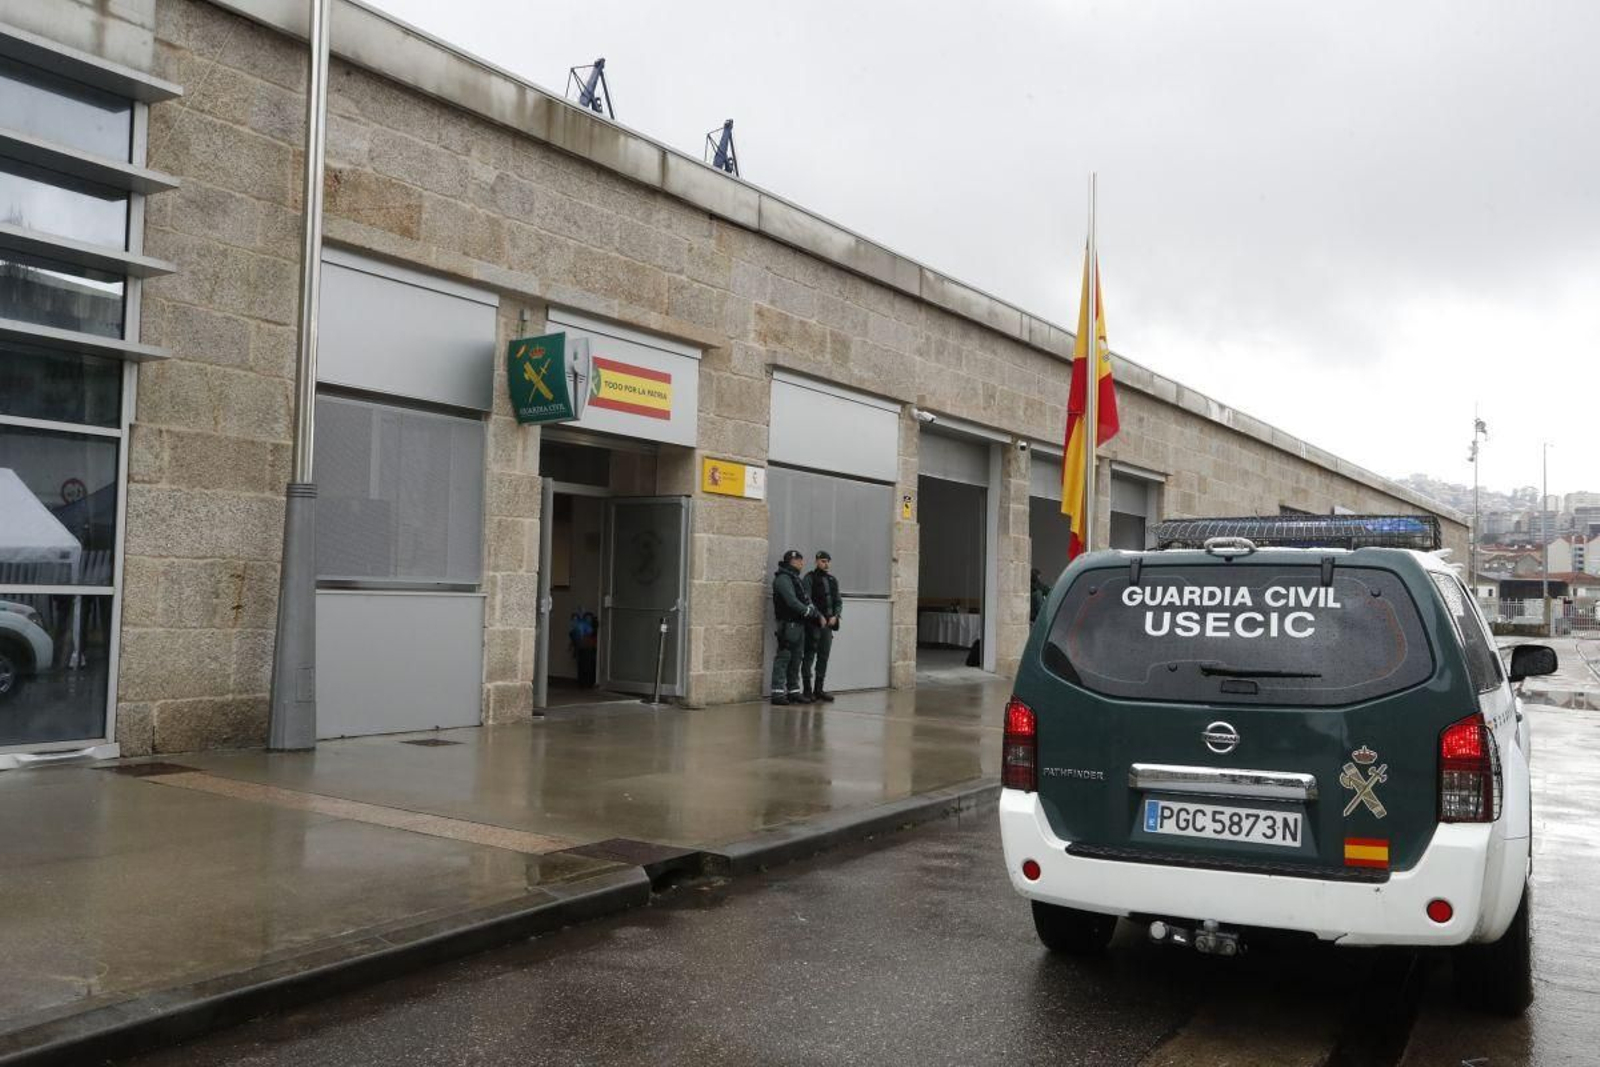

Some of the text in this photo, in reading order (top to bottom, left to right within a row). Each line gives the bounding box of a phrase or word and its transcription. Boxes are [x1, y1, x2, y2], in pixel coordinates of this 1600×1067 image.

[604, 380, 623, 391] TODO
[624, 384, 637, 394] POR
[638, 387, 646, 396] LA
[1121, 586, 1342, 608] GUARDIA CIVIL
[1144, 611, 1316, 638] USECIC
[1043, 767, 1105, 781] PATHFINDER
